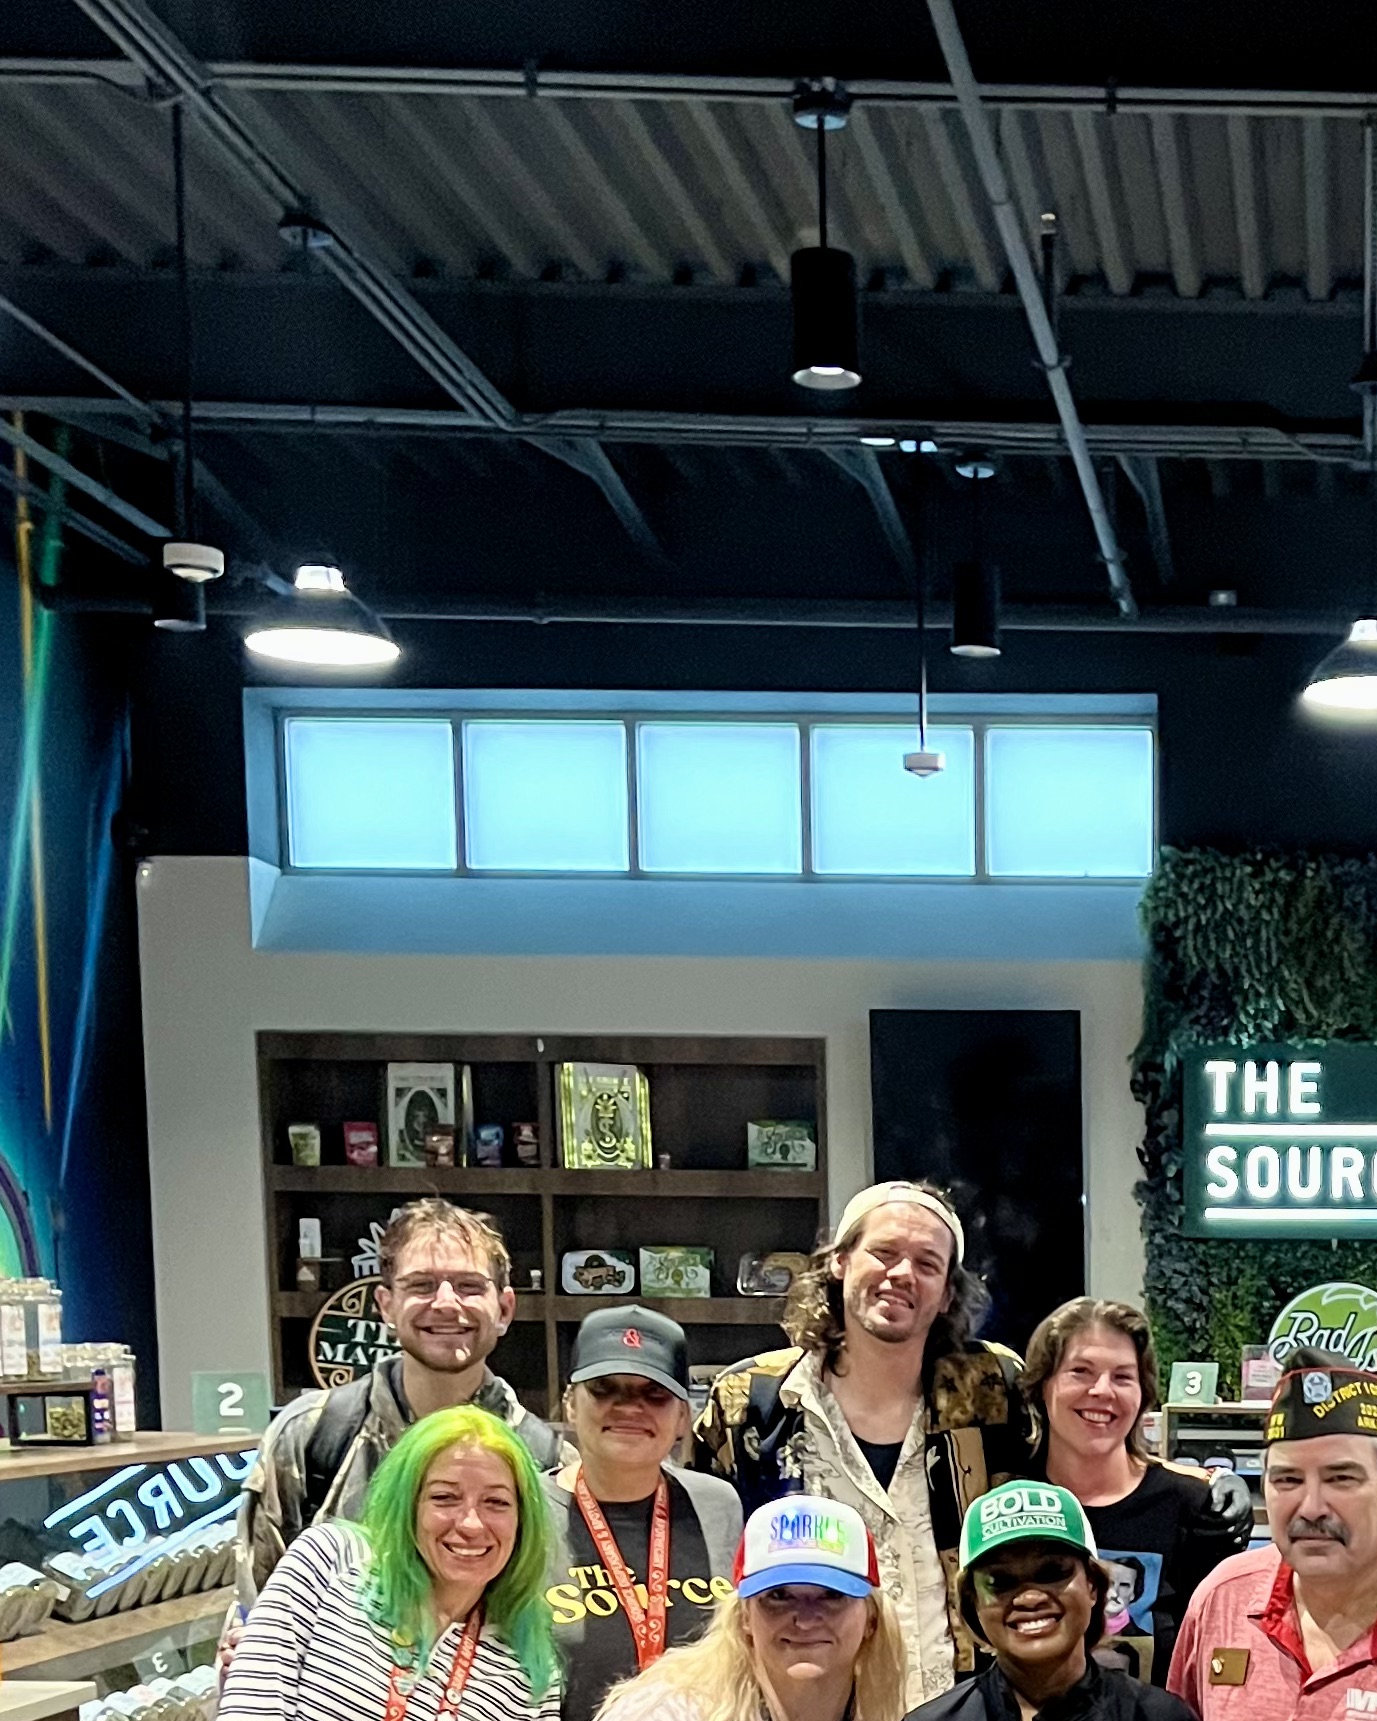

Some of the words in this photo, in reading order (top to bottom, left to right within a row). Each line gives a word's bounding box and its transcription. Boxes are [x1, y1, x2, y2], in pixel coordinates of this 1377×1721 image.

[1204, 1060, 1323, 1115] THE
[347, 1319, 402, 1347] TI
[622, 1327, 641, 1349] &
[317, 1341, 395, 1366] MAT
[1184, 1371, 1203, 1395] 3
[217, 1382, 244, 1417] 2
[1312, 1381, 1362, 1419] DISTRICT
[981, 1489, 1062, 1524] BOLD
[982, 1515, 1066, 1536] CULTIVATION
